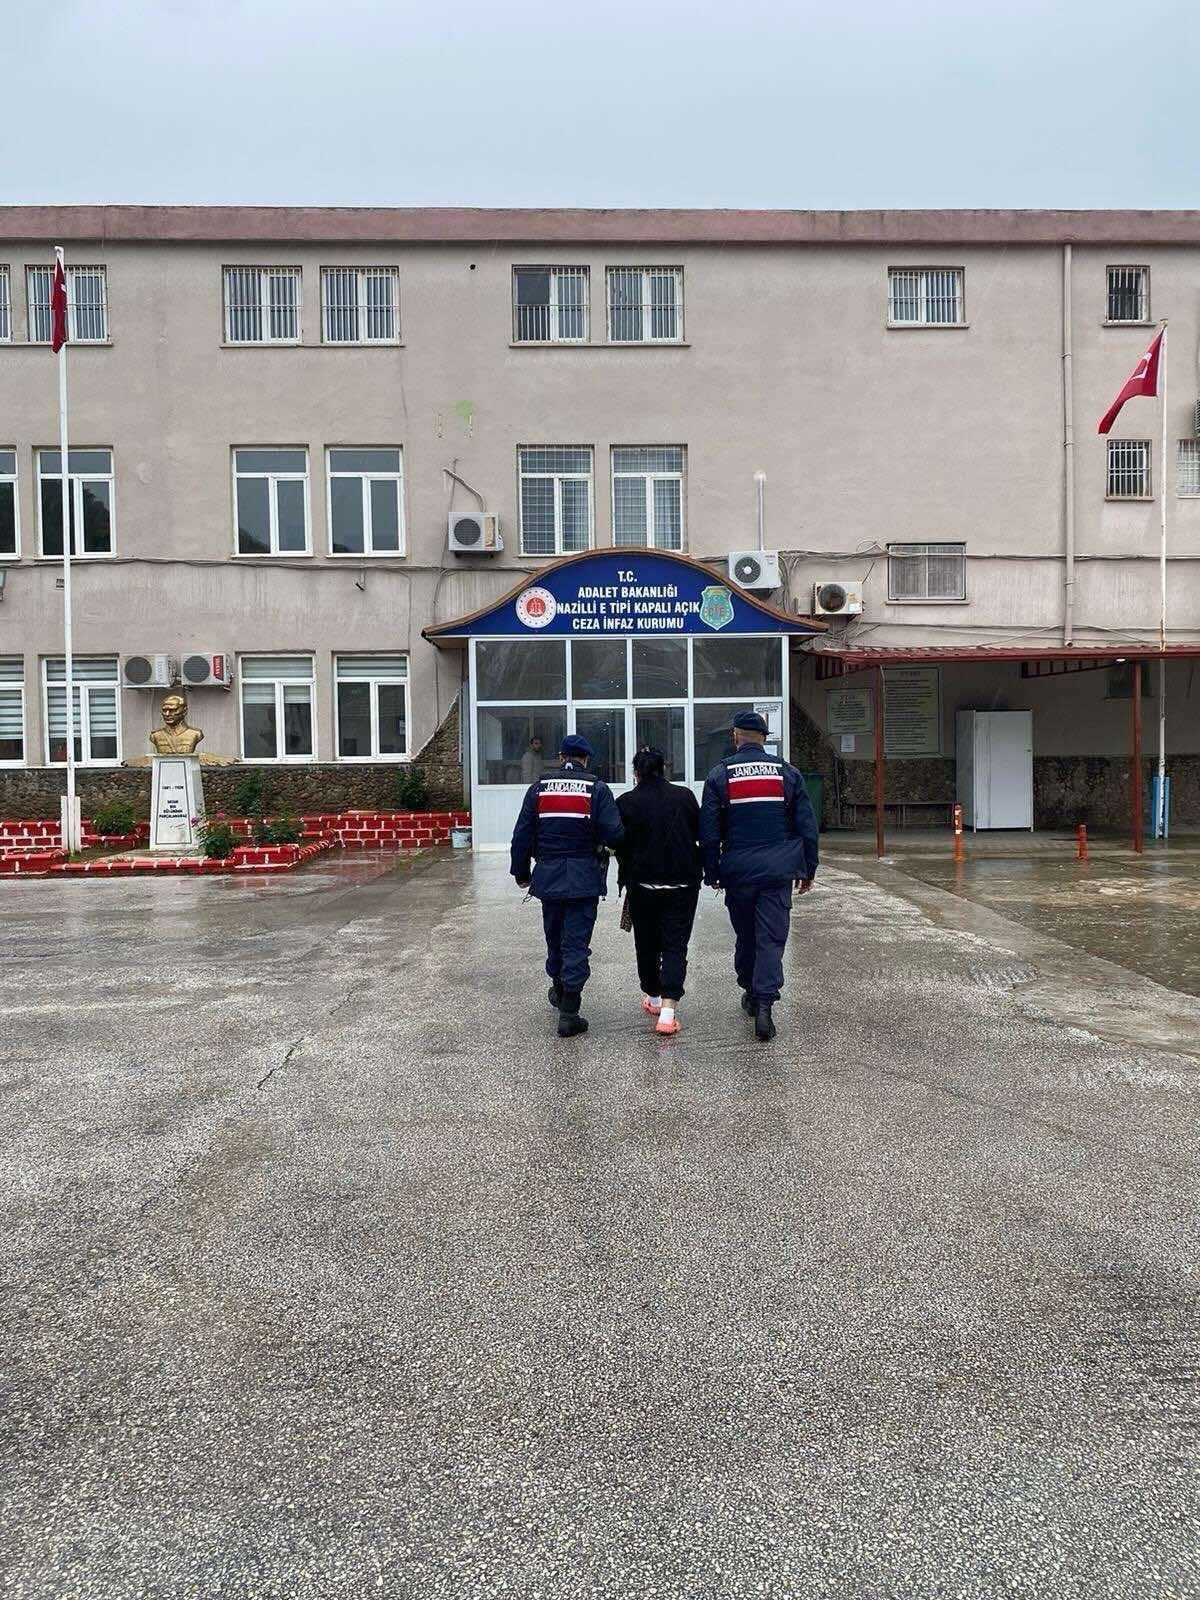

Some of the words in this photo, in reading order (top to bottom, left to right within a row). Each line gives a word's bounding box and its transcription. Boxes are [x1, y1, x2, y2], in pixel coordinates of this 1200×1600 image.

[617, 570, 638, 582] T.C.
[578, 586, 618, 598] ADALET
[621, 584, 678, 598] BAKANLIĞI
[556, 600, 597, 614] NAZİLLİ
[599, 602, 607, 614] E
[609, 600, 631, 614] TİPİ
[634, 602, 671, 614] KAPALI
[674, 602, 700, 616] AÇIK
[572, 618, 600, 629] CEZA
[603, 616, 634, 629] İNFAZ
[637, 617, 684, 629] KURUMU
[732, 765, 779, 777] JANDARMA
[544, 782, 587, 792] JANDARMA
